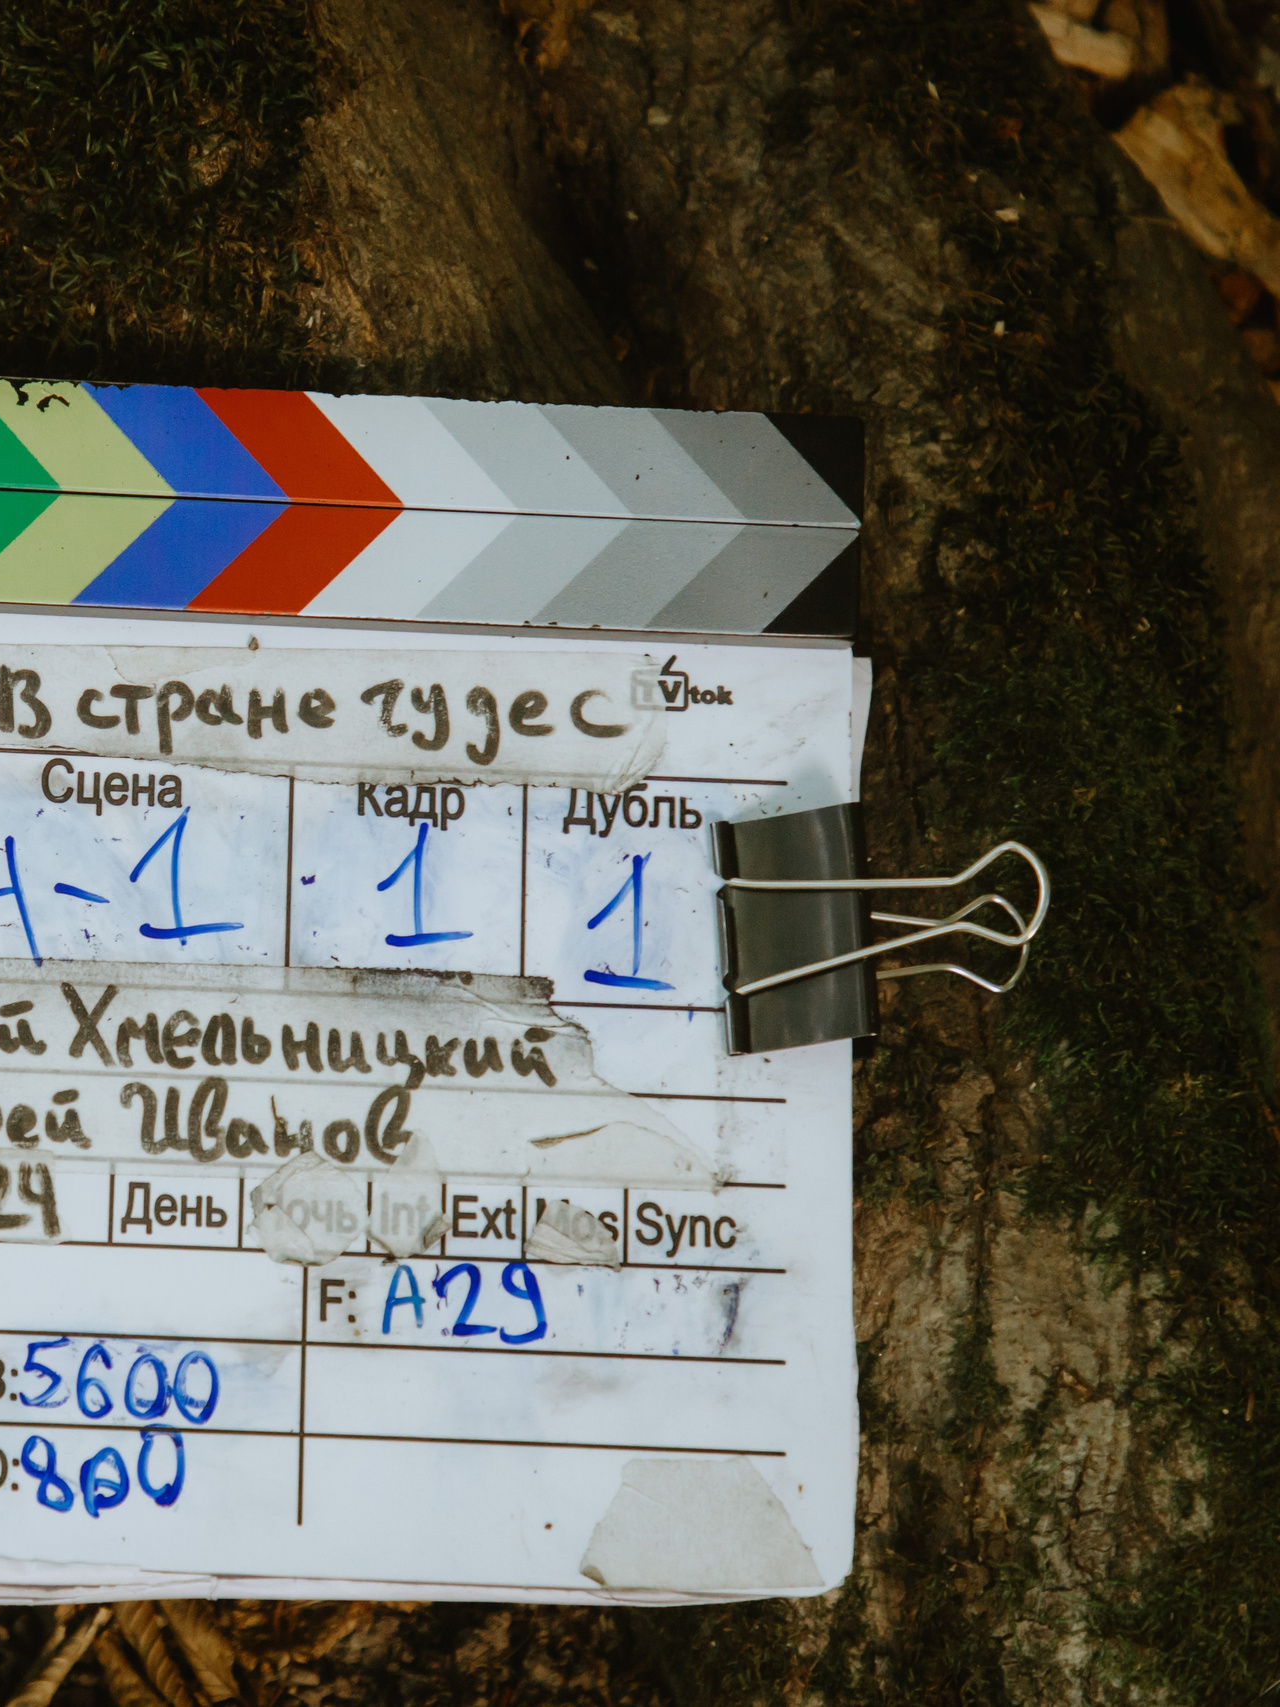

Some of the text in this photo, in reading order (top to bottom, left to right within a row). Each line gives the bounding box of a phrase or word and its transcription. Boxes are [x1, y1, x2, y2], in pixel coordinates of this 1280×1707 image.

[77, 680, 337, 754] стране
[360, 678, 631, 765] чудес
[40, 758, 183, 815] Сцена
[357, 783, 466, 831] Кадр
[563, 783, 703, 838] Дубль
[377, 822, 474, 947] 1
[584, 851, 676, 991] 1
[60, 982, 558, 1089] Хмельницкий
[120, 1076, 412, 1163] Иванов
[120, 1181, 228, 1234] День
[452, 1195, 517, 1240] Ext
[635, 1202, 738, 1258] Sync
[319, 1278, 356, 1322] F:
[19, 1336, 219, 1424] 5600
[21, 1424, 185, 1519] 800
